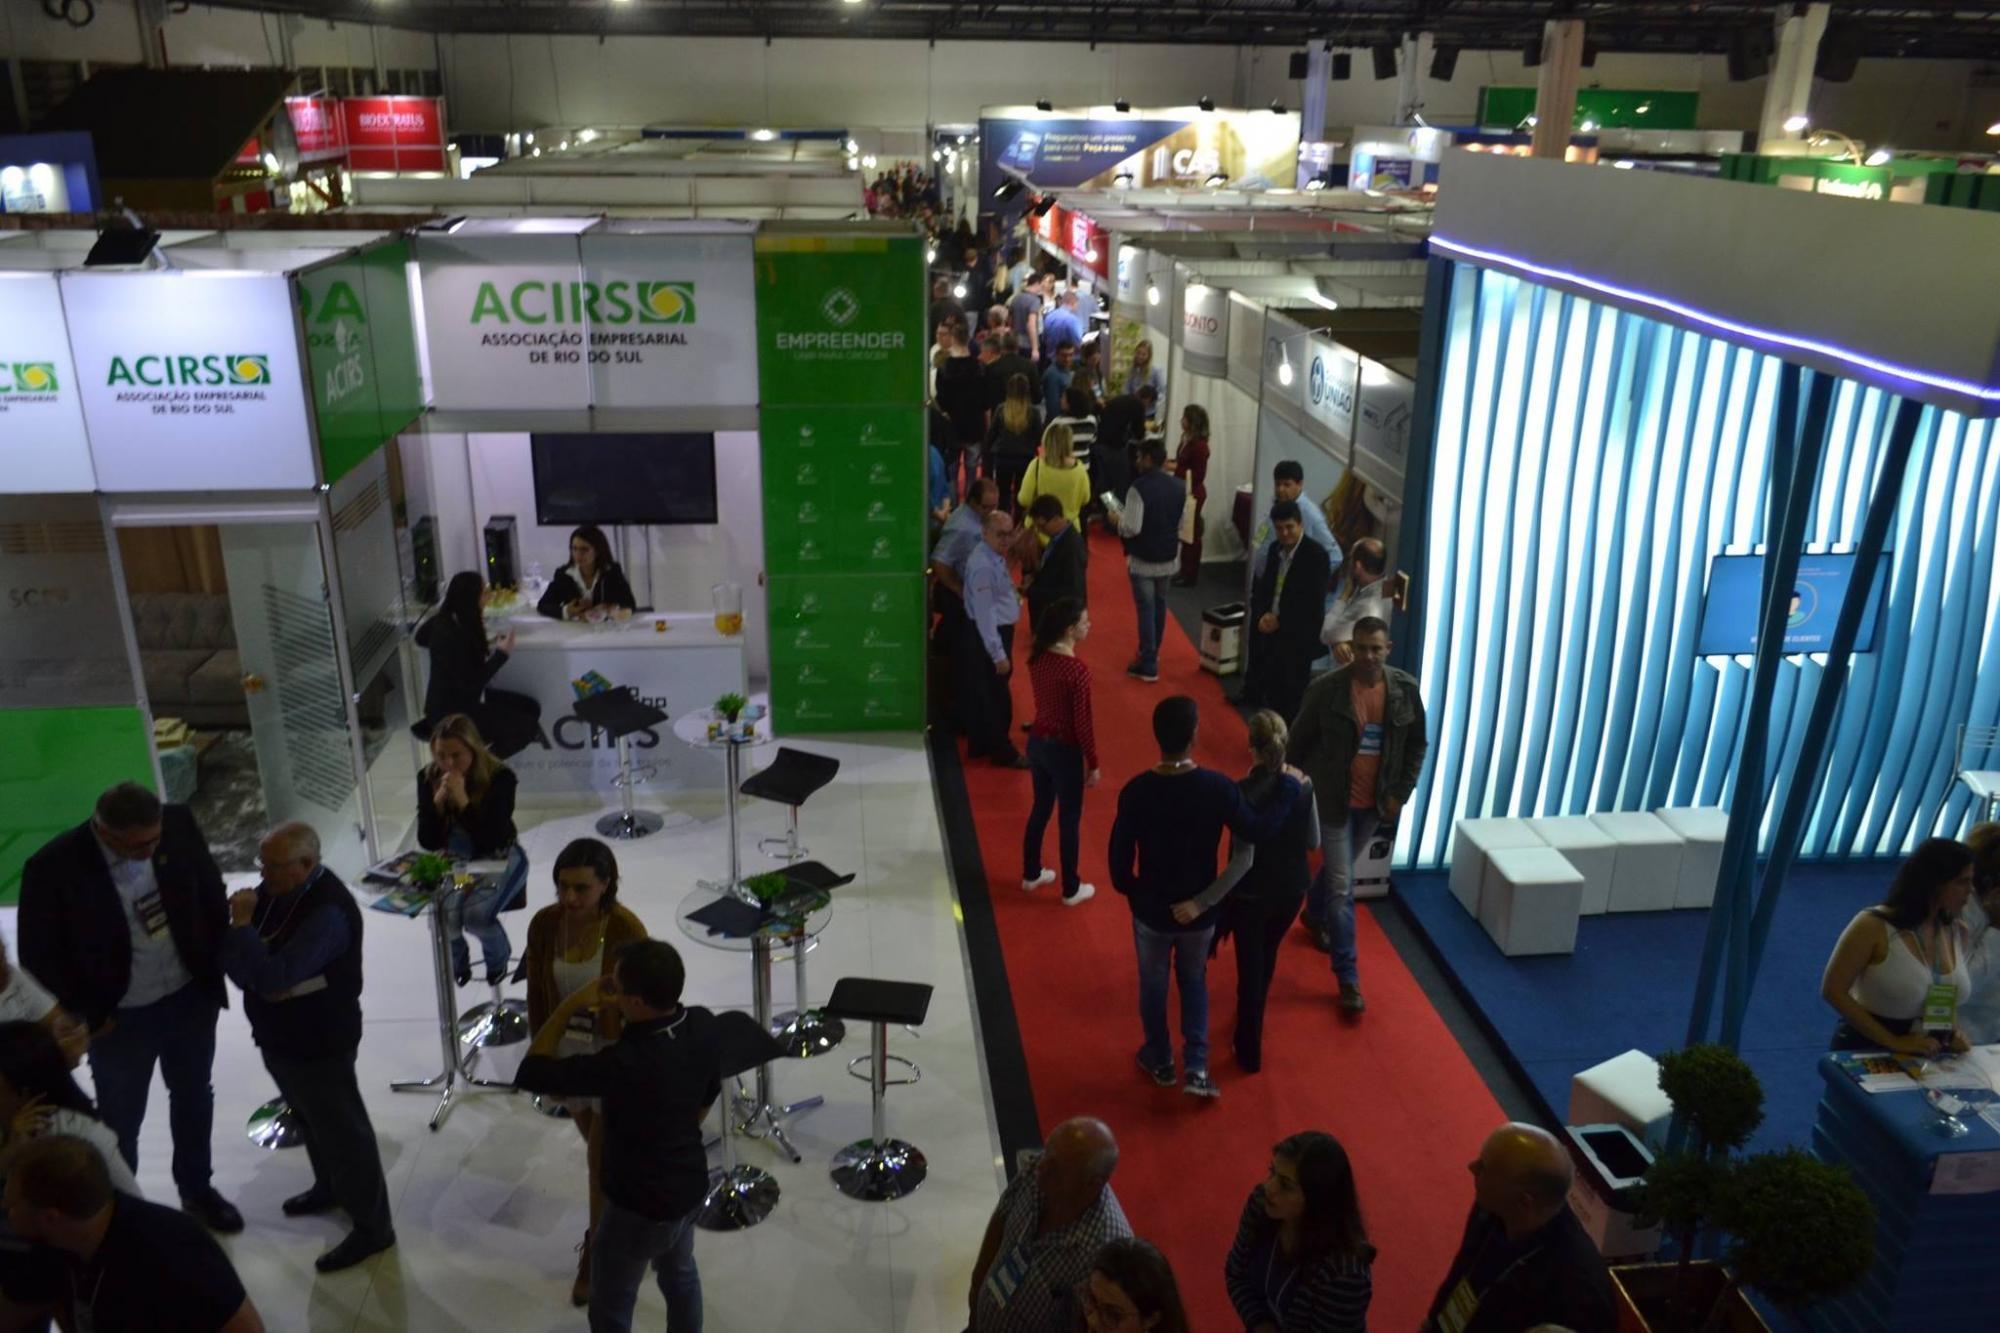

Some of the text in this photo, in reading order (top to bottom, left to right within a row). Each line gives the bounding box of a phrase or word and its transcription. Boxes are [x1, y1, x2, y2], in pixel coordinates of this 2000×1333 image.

[470, 280, 634, 325] ACIRS
[481, 329, 687, 348] ASSOCIAÇÃO EMPRESARIAL
[776, 331, 906, 350] EMPREENDER
[529, 351, 643, 364] DE RIO DO SUL
[106, 355, 224, 386] ACIRS
[116, 389, 266, 402] ASSOCIAÇÃO EMPRESARIAL
[152, 404, 235, 415] DE RIO DO SUL
